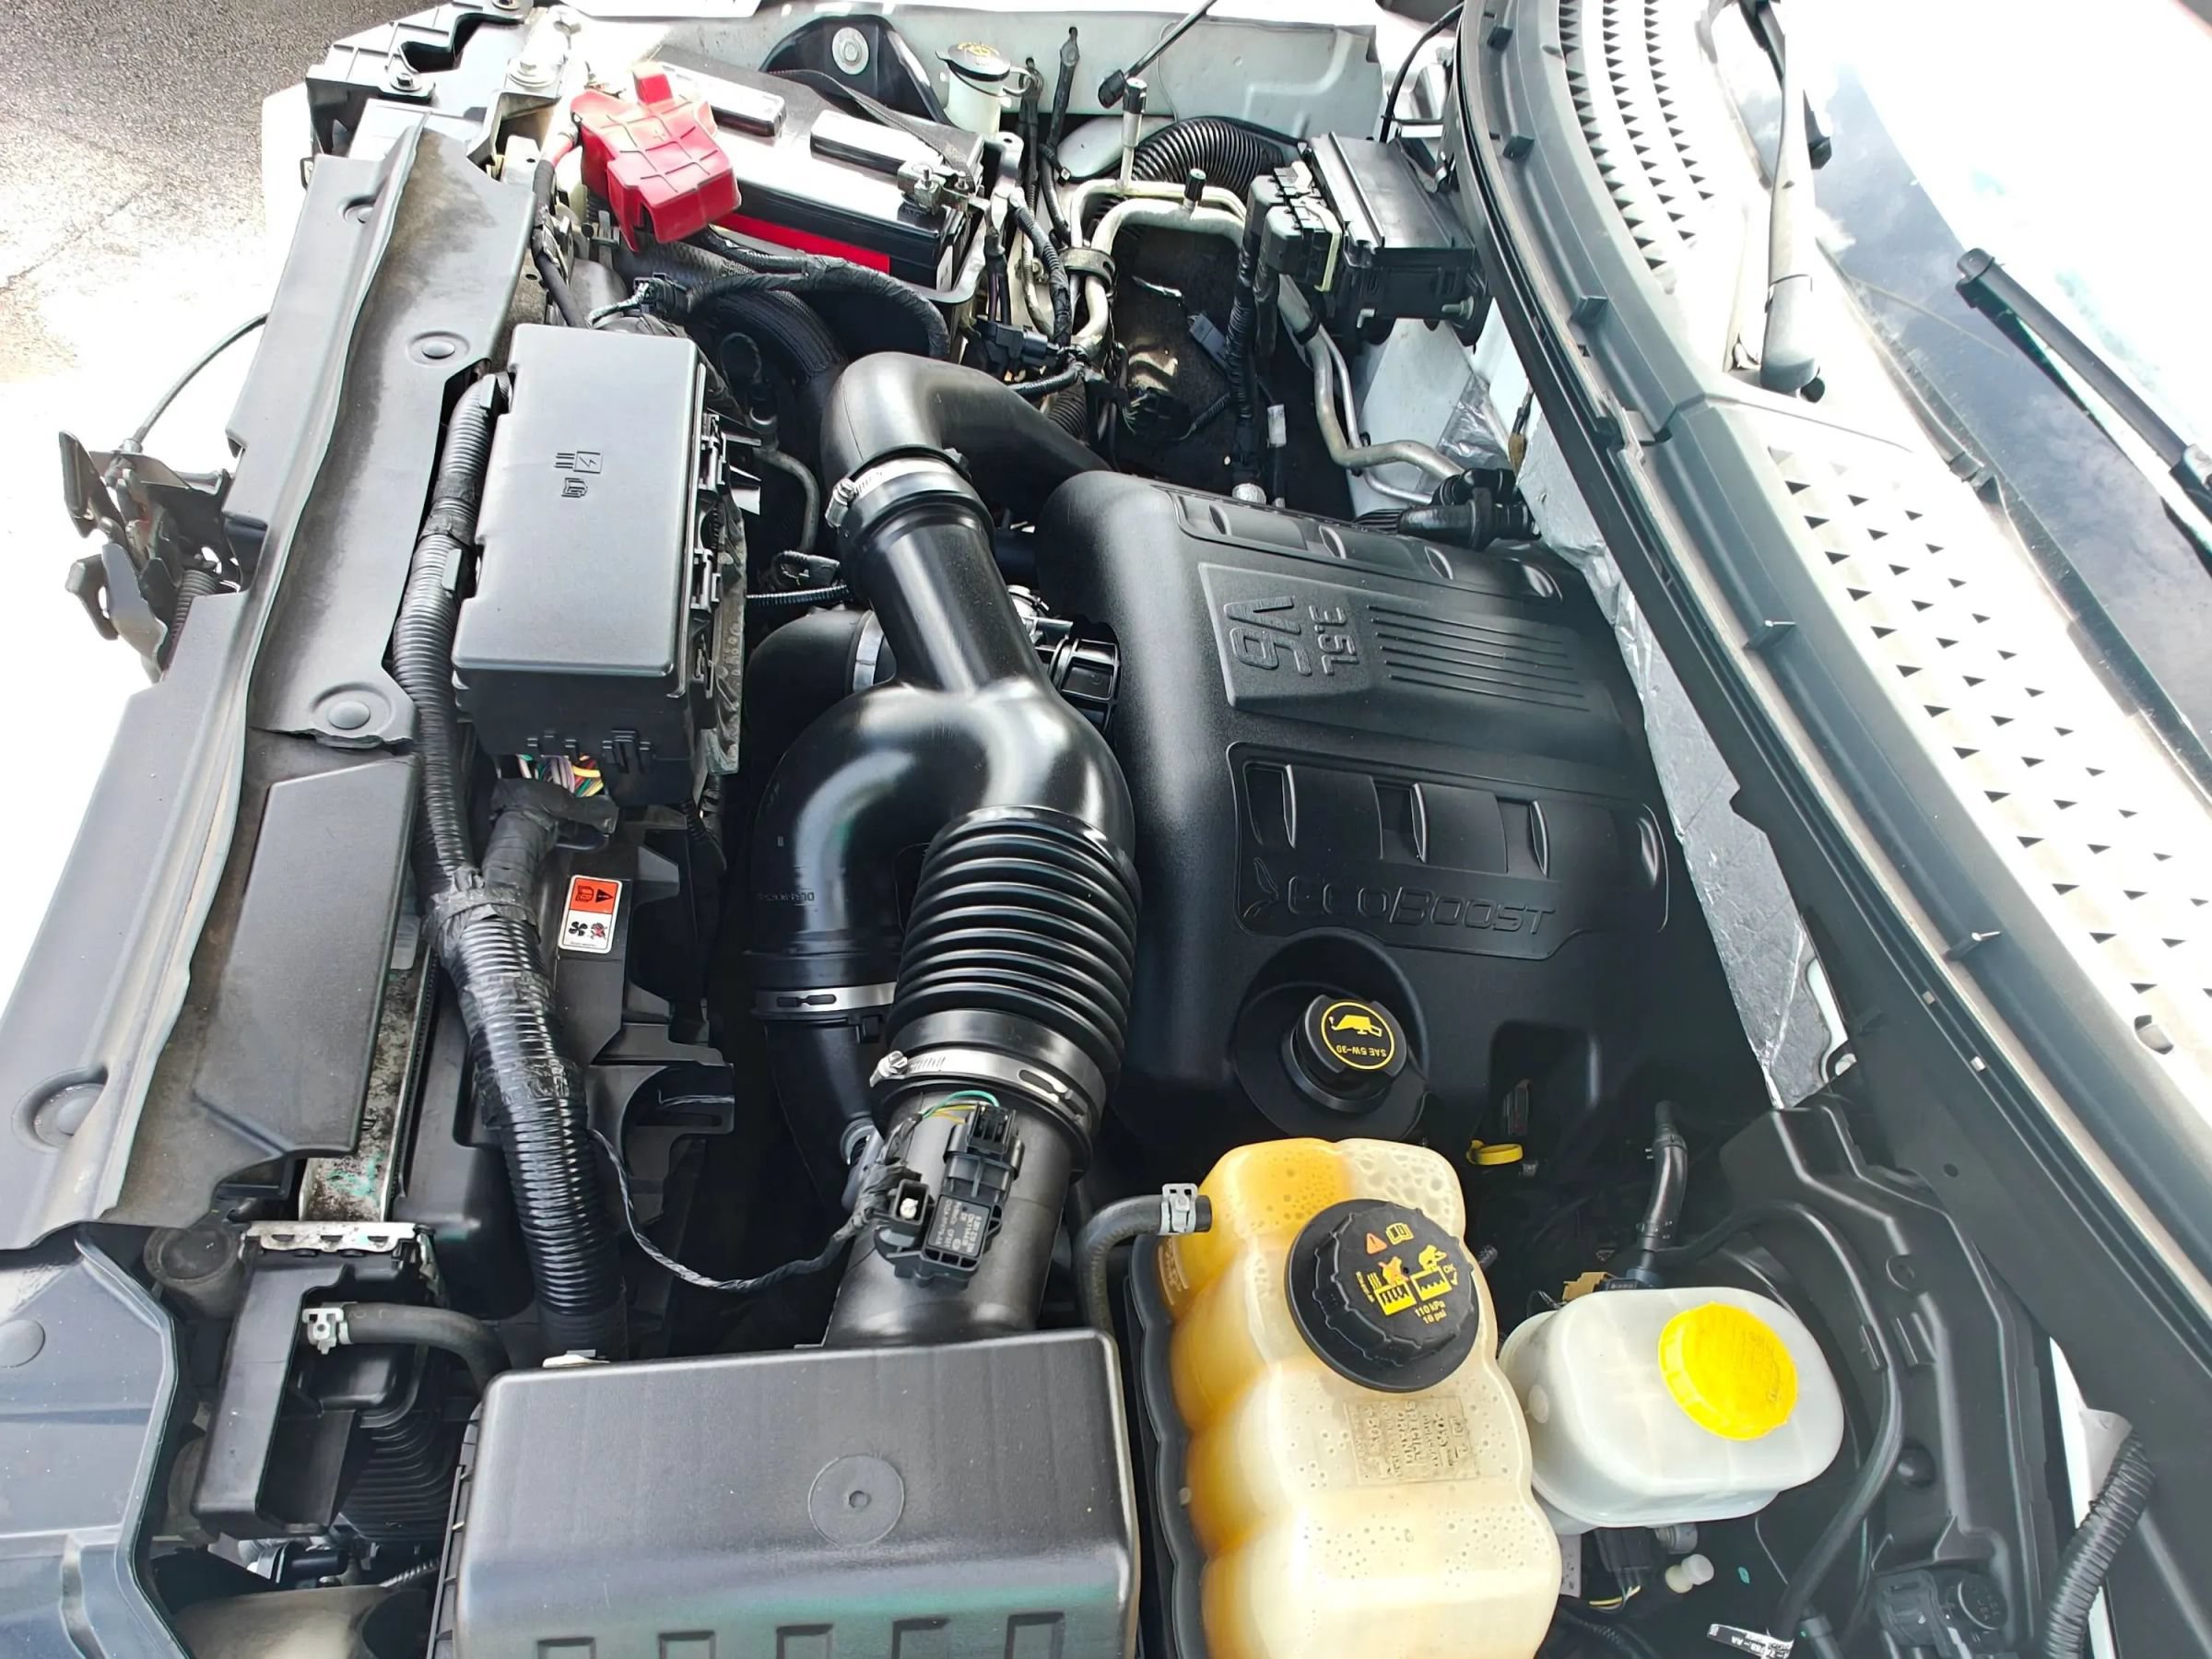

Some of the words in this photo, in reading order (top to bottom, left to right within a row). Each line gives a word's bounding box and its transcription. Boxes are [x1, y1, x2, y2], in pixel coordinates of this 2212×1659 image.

[1226, 596, 1312, 677] V6
[1311, 605, 1359, 677] 3.5L
[1335, 1045, 1368, 1055] 5W-30
[1370, 1048, 1387, 1057] SAE
[1443, 1264, 1456, 1275] OK
[1415, 1304, 1430, 1319] 110
[1428, 1300, 1446, 1312] kPa
